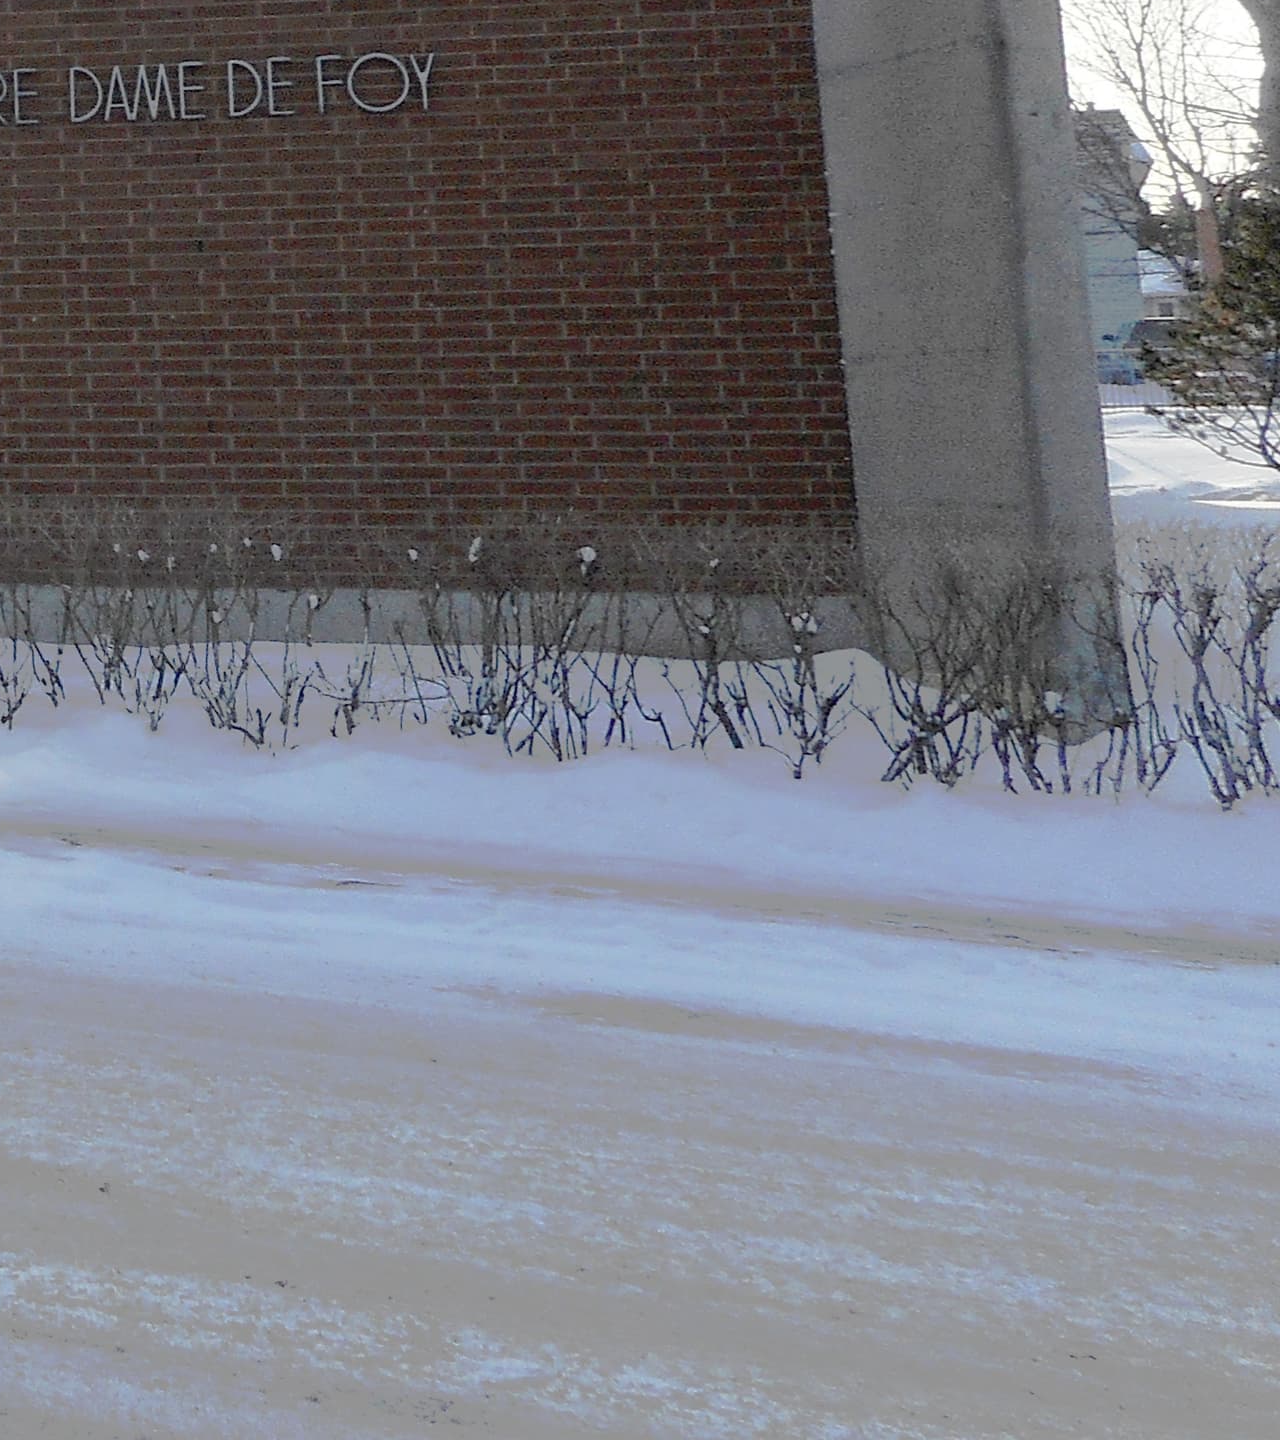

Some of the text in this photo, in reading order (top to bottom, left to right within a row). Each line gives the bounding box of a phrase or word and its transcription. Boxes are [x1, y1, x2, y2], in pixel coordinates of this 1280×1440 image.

[70, 62, 206, 123] DAME
[228, 57, 294, 117] DE
[316, 53, 435, 114] FOY
